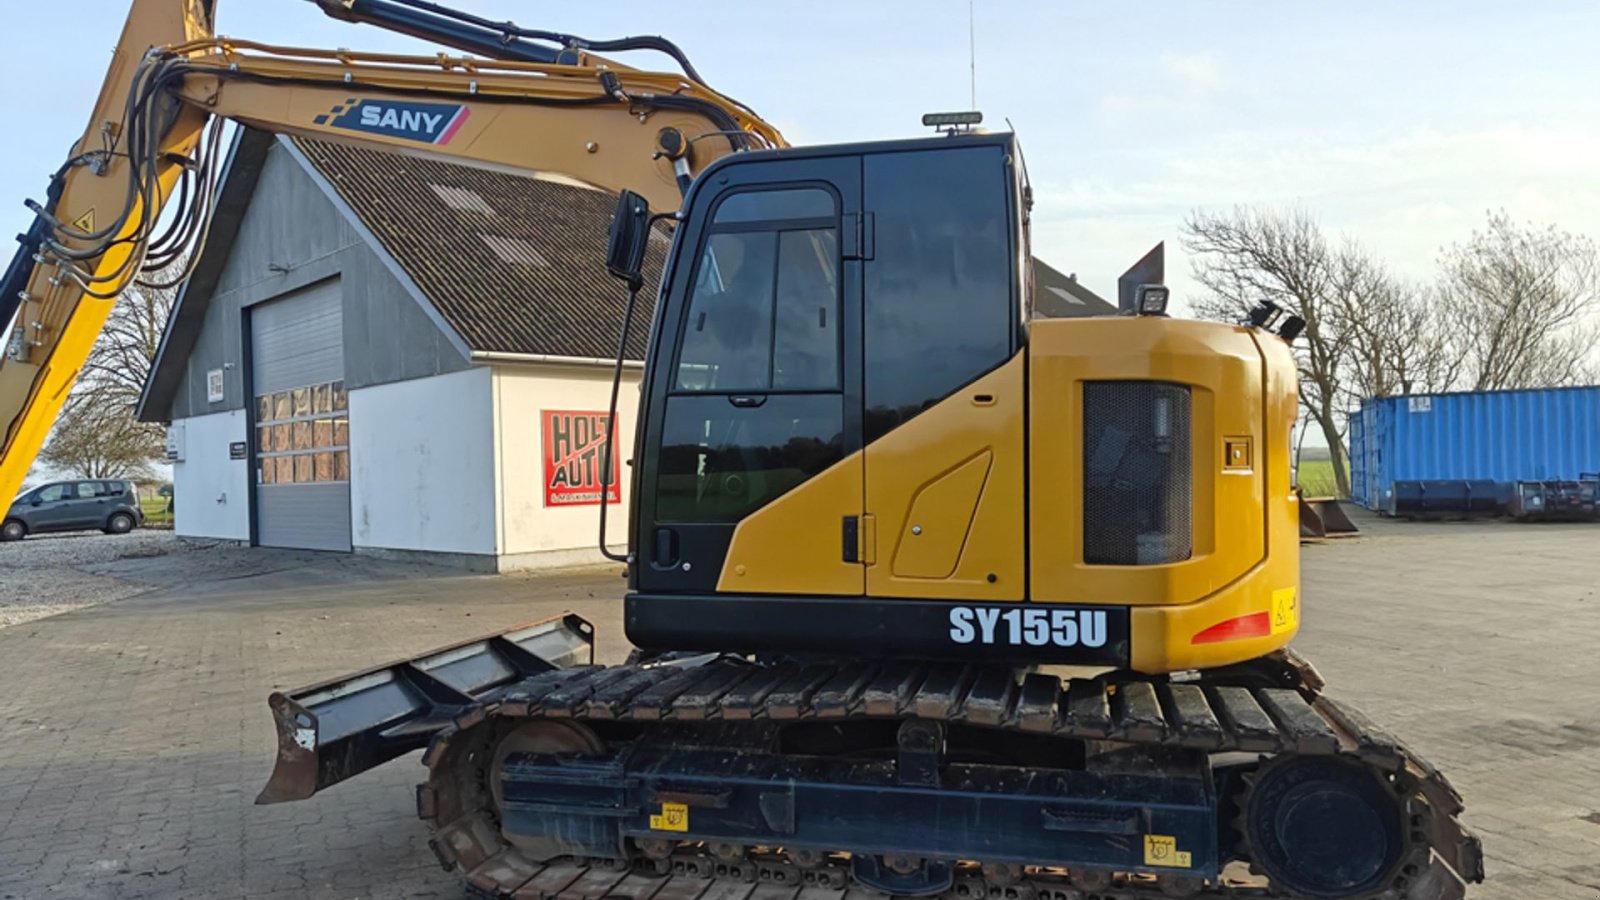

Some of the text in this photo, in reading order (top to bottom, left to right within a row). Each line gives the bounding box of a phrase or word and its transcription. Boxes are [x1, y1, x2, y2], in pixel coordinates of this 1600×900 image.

[360, 104, 443, 134] SANY
[552, 415, 611, 464] HOLT
[550, 442, 614, 488] AUTO
[949, 606, 1108, 648] SY155U
